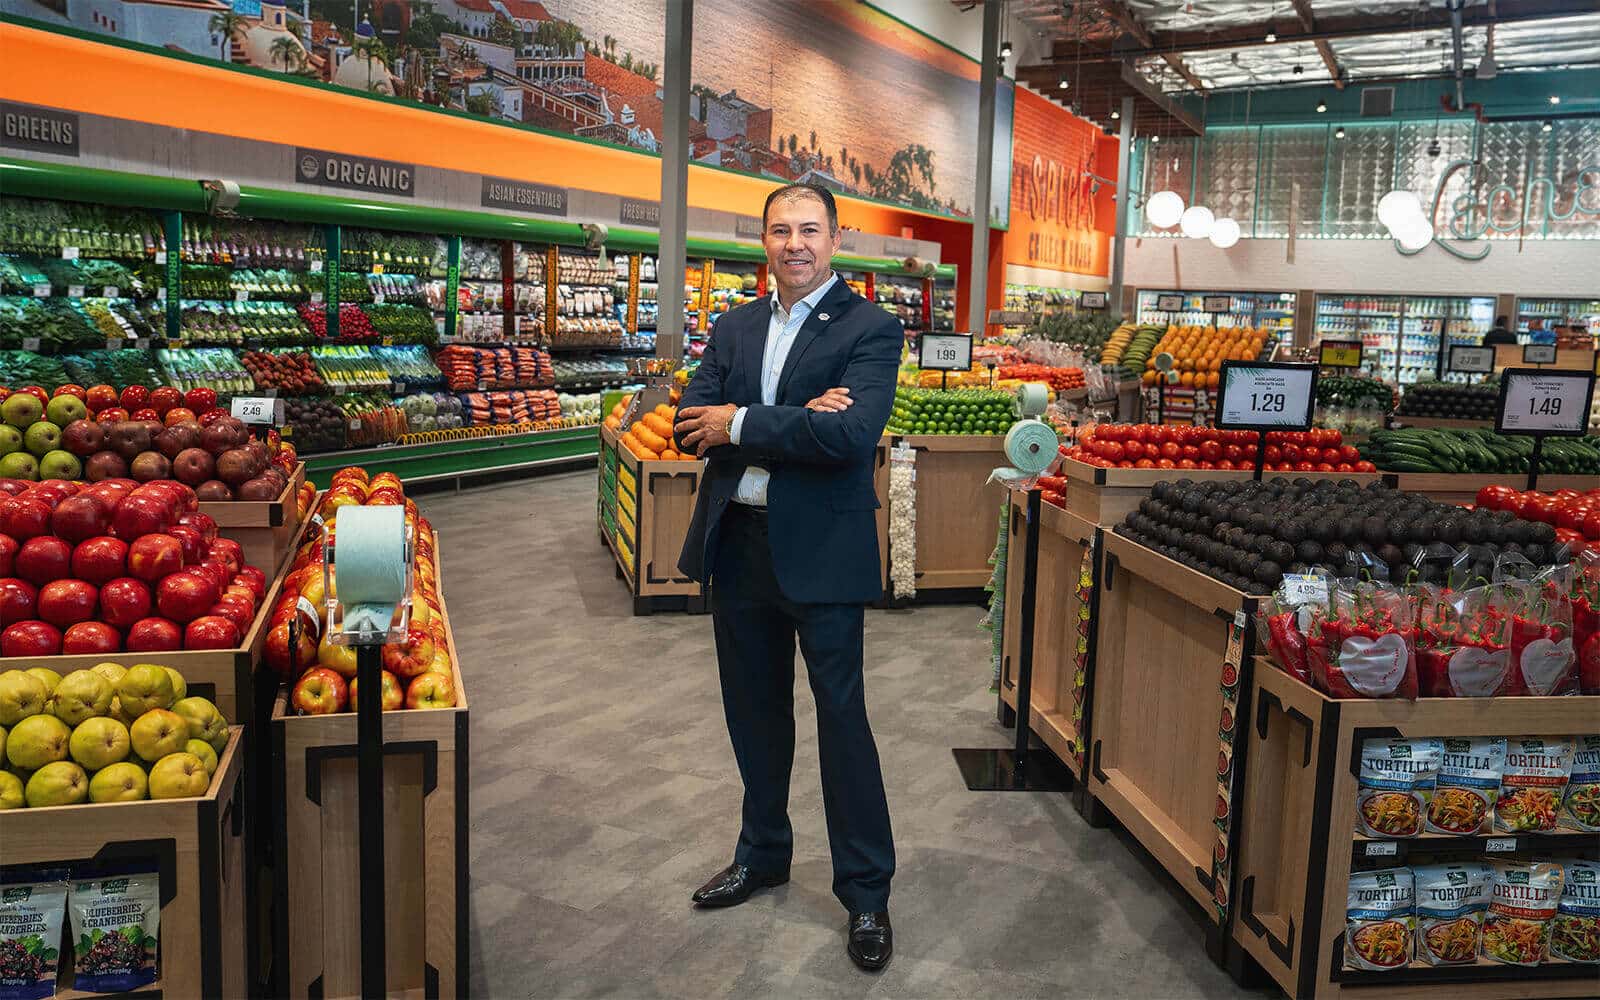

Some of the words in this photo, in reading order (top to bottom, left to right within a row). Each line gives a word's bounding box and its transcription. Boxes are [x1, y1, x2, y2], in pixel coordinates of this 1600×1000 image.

[5, 112, 73, 145] GREENS
[325, 158, 410, 191] ORGANIC
[488, 183, 515, 202] ASIAN
[516, 188, 562, 210] ESSENTIALS
[623, 202, 645, 219] FRESH
[167, 250, 178, 307] ORGANIC
[327, 259, 338, 311] ORGANIC
[936, 349, 956, 361] 1.99
[1250, 392, 1286, 413] 1.29
[1528, 397, 1562, 416] 1.49
[242, 406, 261, 416] 2.49
[1366, 758, 1430, 774] TORTILLA
[1446, 766, 1472, 776] STRIPS
[1522, 767, 1546, 776] STRIPS
[1356, 886, 1413, 901] TORTILLA
[1431, 886, 1481, 901] TORTILLA
[87, 912, 146, 928] CRANBERRIES
